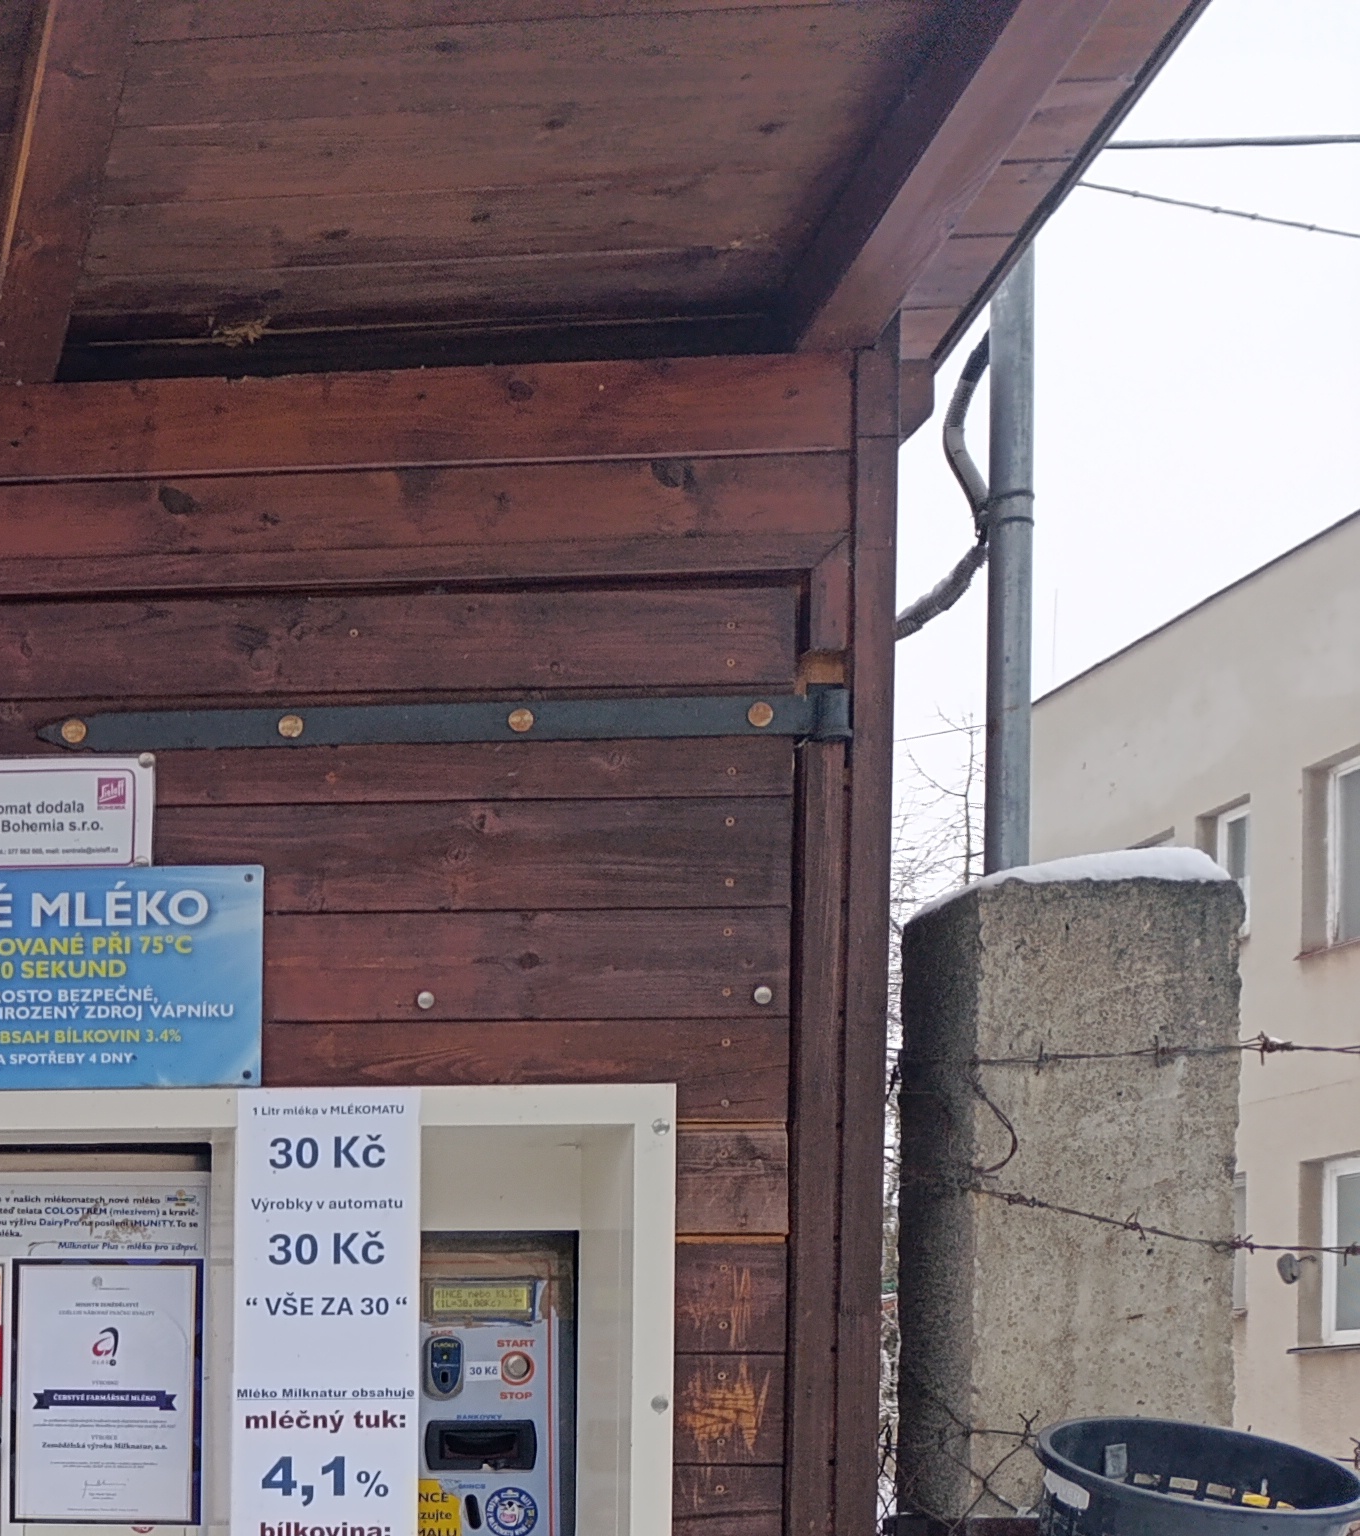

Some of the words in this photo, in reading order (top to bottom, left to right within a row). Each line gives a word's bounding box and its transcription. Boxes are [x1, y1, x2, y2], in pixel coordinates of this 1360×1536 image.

[36, 801, 84, 814] dodala
[2, 820, 64, 832] Bohemia
[68, 820, 104, 832] s.r.o.
[32, 880, 209, 926] MLÉKO
[93, 932, 131, 953] PŘI
[22, 960, 126, 978] SEKUND
[58, 985, 157, 1002] BEZPEČNÉ,
[85, 1005, 142, 1021] ZDROJ
[150, 1001, 233, 1017] VÁPNÍKU
[55, 1027, 140, 1044] BÍLKOVIN
[146, 1028, 181, 1043] 3.4%
[10, 1051, 85, 1064] SPOTŘEBY
[89, 1053, 97, 1064] 4
[100, 1051, 134, 1064] DNY
[252, 1106, 258, 1116] 1
[261, 1106, 280, 1116] Litr
[282, 1106, 319, 1116] mléka
[320, 1108, 328, 1116] v
[330, 1104, 405, 1115] MLÉKOMATU
[270, 1138, 318, 1169] 30
[334, 1134, 385, 1168] Kč
[251, 1199, 312, 1212] Výrobky
[316, 1200, 325, 1210] v
[328, 1198, 403, 1209] automatu
[269, 1234, 318, 1265] 30
[334, 1231, 384, 1264] Kč
[265, 1292, 313, 1315] VŠE
[321, 1297, 353, 1315] ZA
[361, 1298, 389, 1315] 30
[497, 1339, 535, 1348] START
[469, 1367, 482, 1375] 30
[484, 1366, 498, 1375] Kč
[236, 1388, 277, 1399] Mléko
[282, 1388, 347, 1398] Milknatur
[352, 1388, 415, 1399] obsahuje
[499, 1391, 533, 1400] STOP
[246, 1410, 344, 1433] mléčný
[354, 1410, 405, 1428] tuk:
